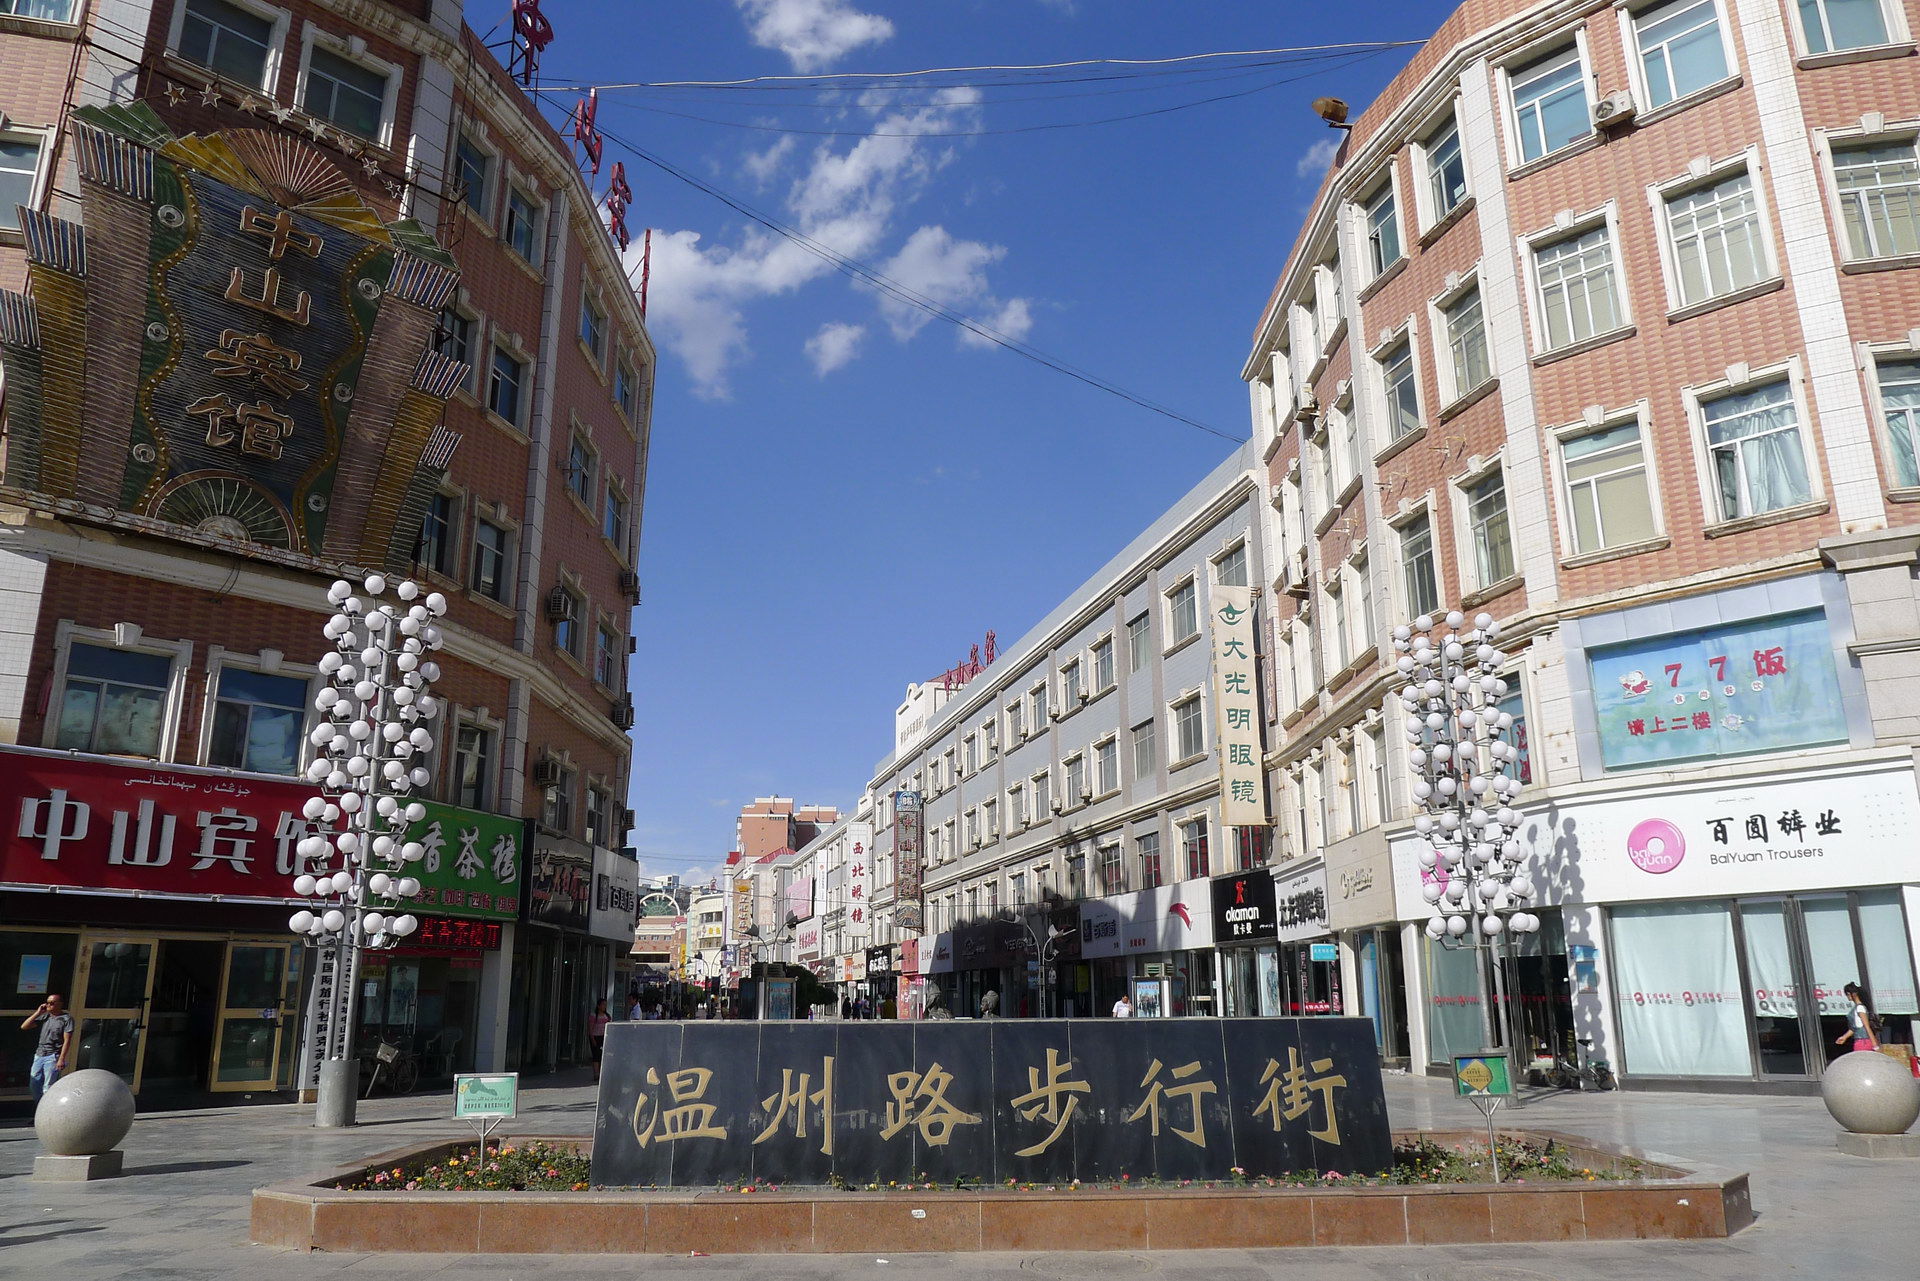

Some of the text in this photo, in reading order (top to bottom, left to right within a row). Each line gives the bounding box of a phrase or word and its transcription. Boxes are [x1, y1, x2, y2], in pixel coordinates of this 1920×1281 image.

[1222, 636, 1257, 805] 大光明眼镜
[1628, 711, 1711, 736] 请上二楼
[388, 820, 517, 884] 香茶楼
[850, 842, 865, 924] 西北眼镜
[1767, 847, 1824, 861] Trousers
[1225, 906, 1260, 923] okaman
[632, 1046, 1348, 1156] 温州路步行街
